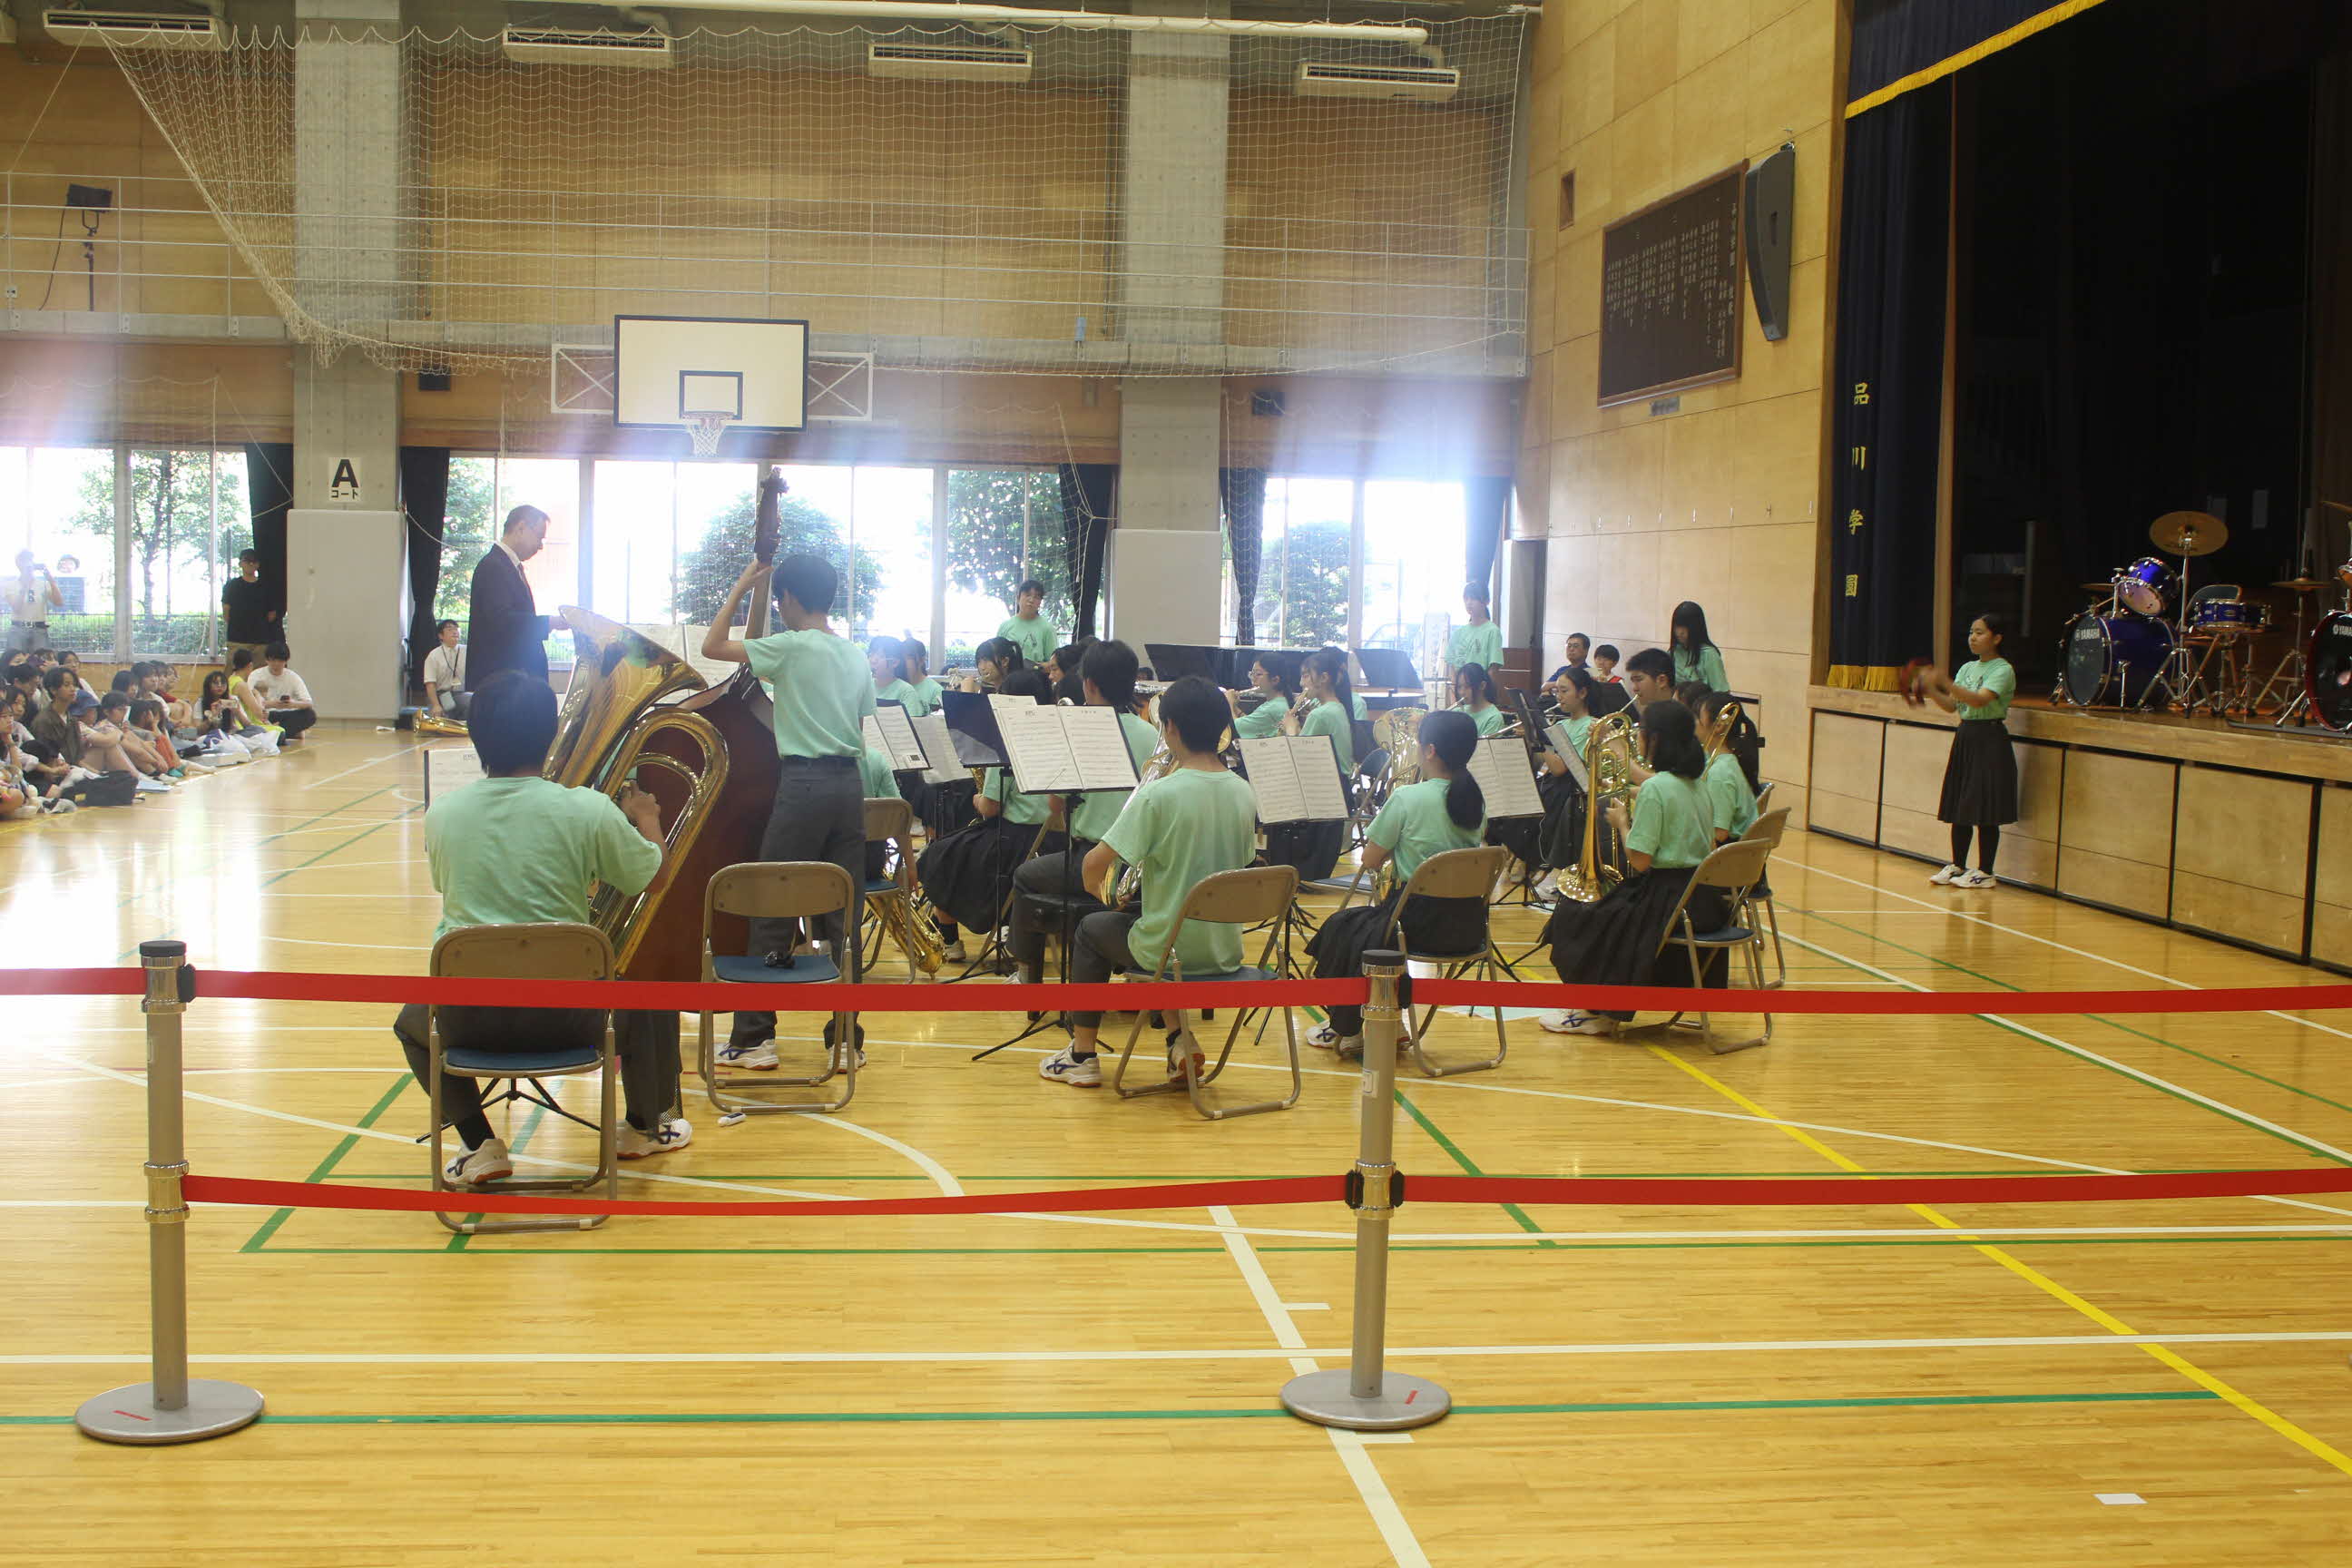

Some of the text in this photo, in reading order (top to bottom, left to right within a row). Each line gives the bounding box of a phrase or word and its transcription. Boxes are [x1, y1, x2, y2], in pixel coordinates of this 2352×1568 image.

[331, 458, 359, 487] A
[331, 488, 358, 500] コート
[1845, 382, 1870, 597] 品川学園
